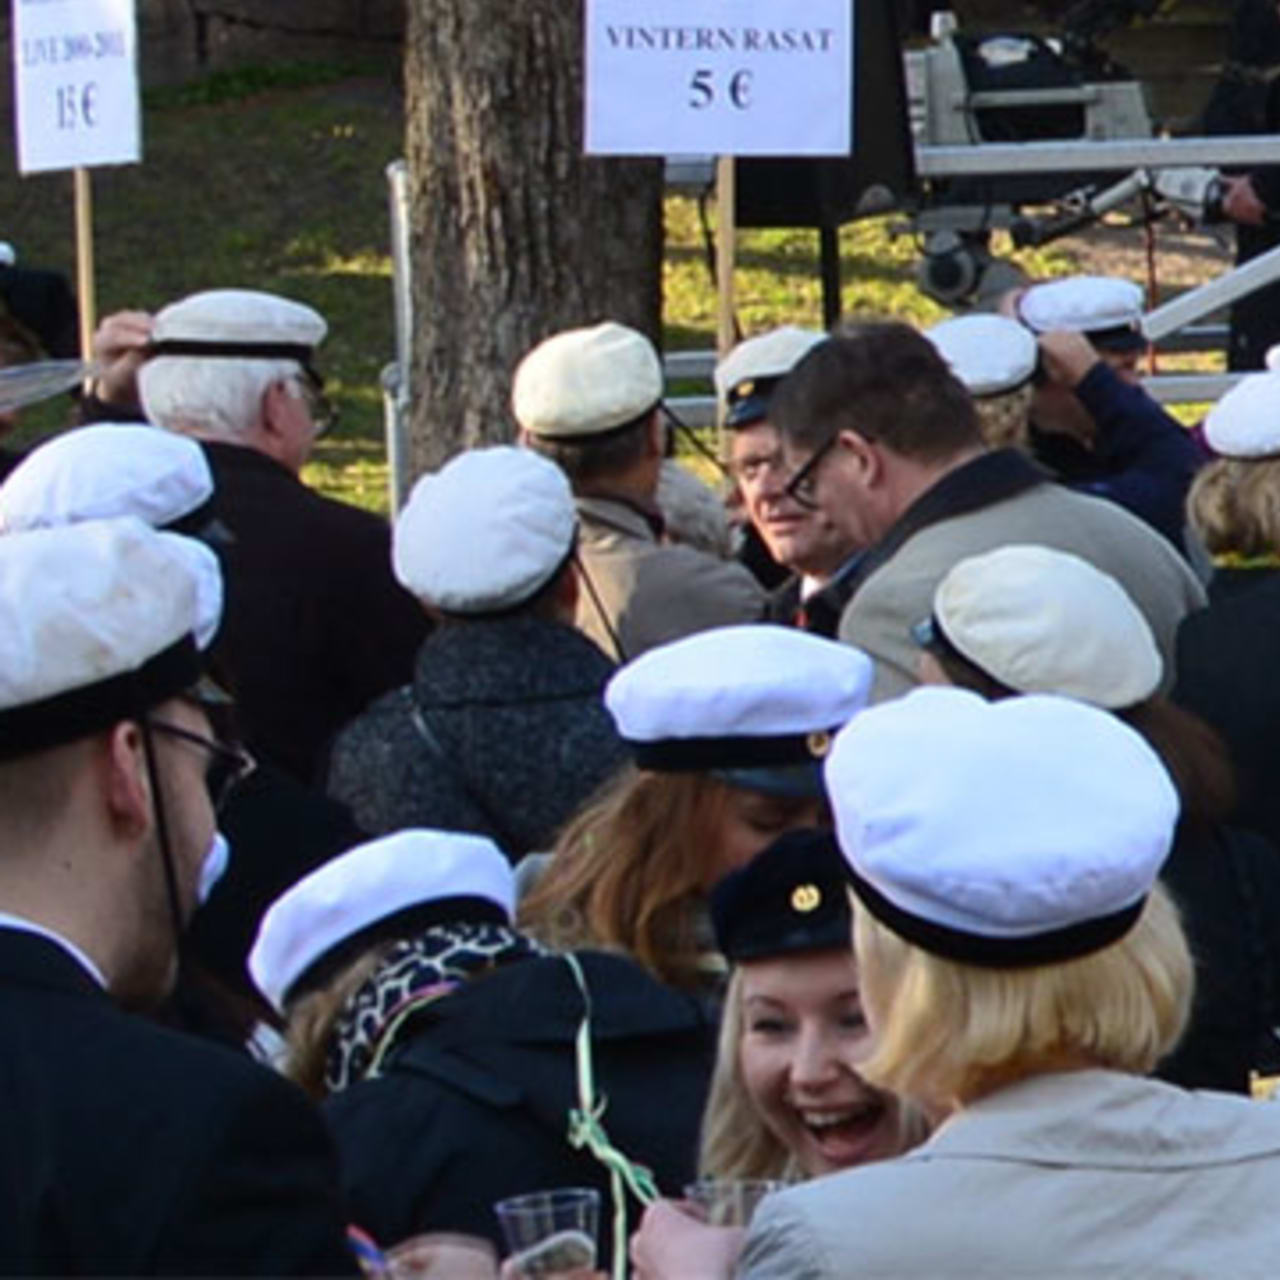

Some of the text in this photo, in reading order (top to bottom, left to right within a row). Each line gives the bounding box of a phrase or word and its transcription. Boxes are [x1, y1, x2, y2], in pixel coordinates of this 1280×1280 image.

[605, 24, 833, 52] VINTERN RASAT
[81, 82, 98, 128] €
[688, 67, 755, 111] 5 €
